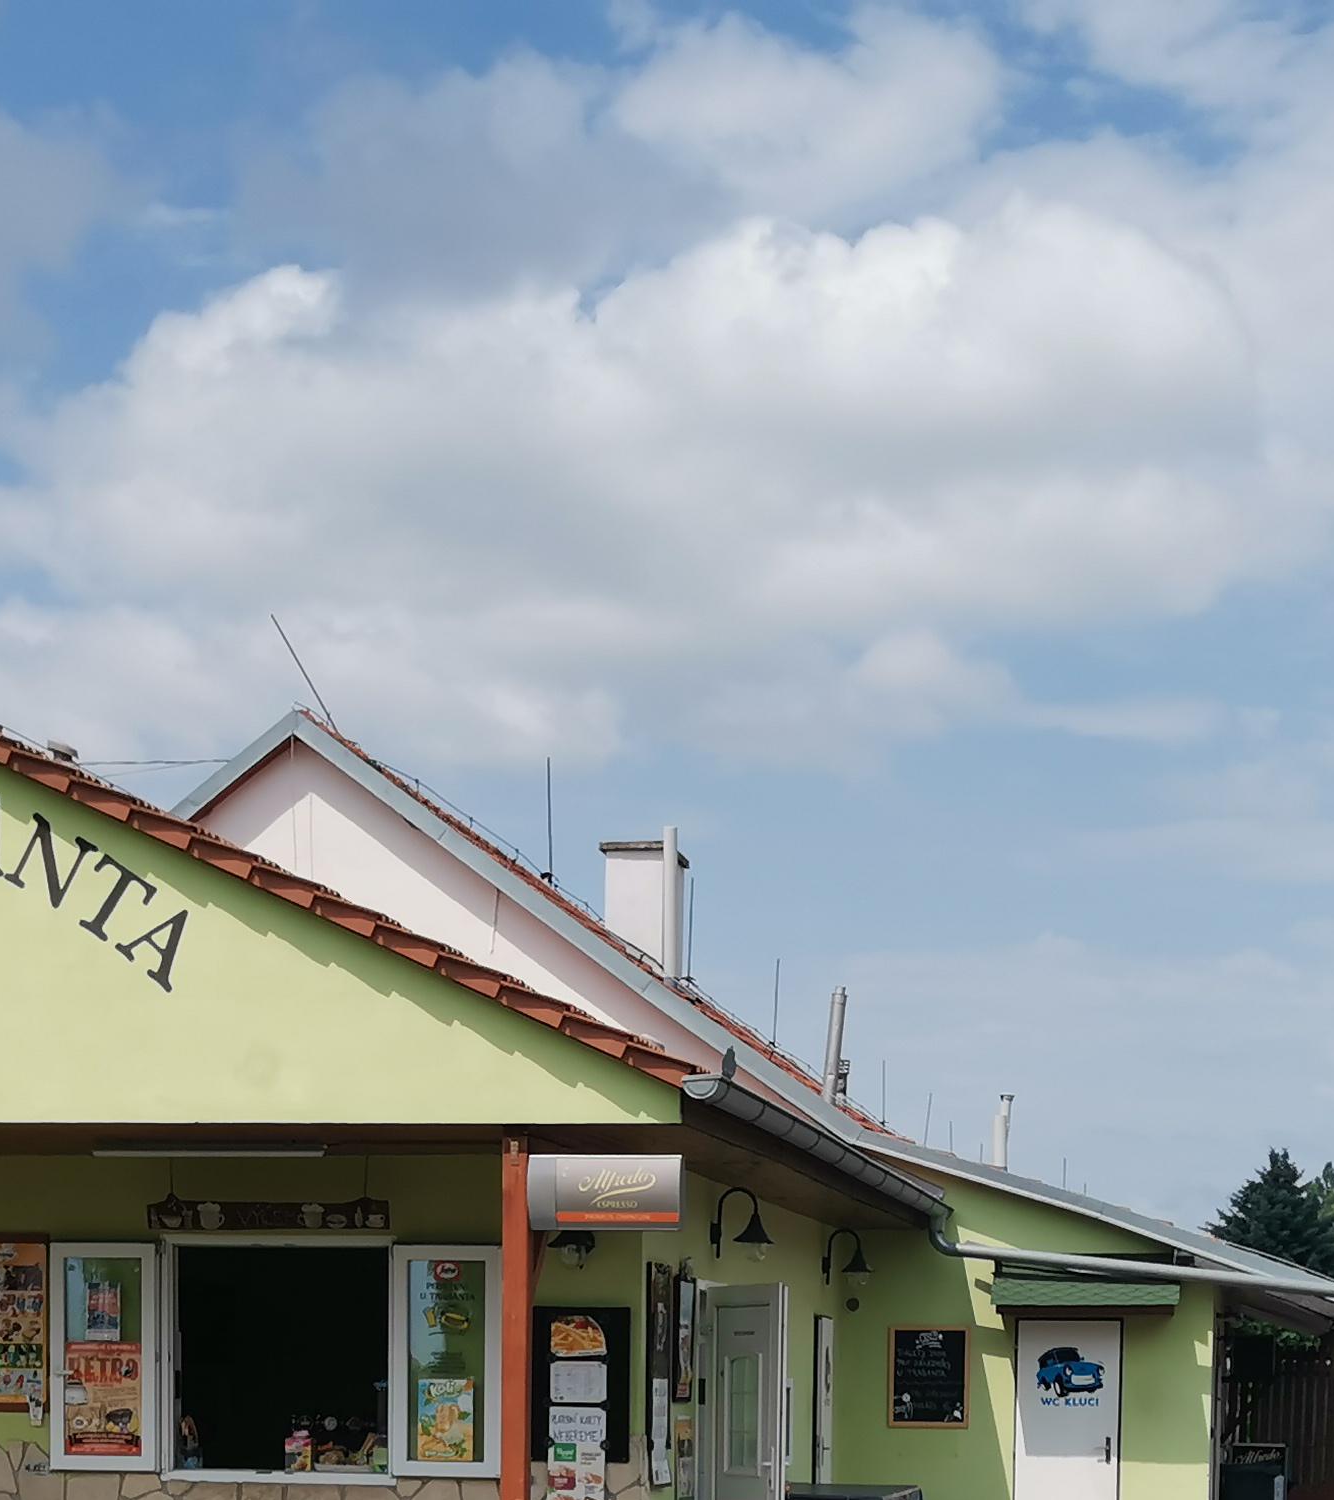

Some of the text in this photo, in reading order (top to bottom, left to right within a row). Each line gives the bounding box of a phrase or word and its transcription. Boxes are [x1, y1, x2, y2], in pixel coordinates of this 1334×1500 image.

[578, 1168, 657, 1199] Alfredo
[67, 1356, 139, 1381] RETRO
[1041, 1397, 1099, 1406] WC KLUCI
